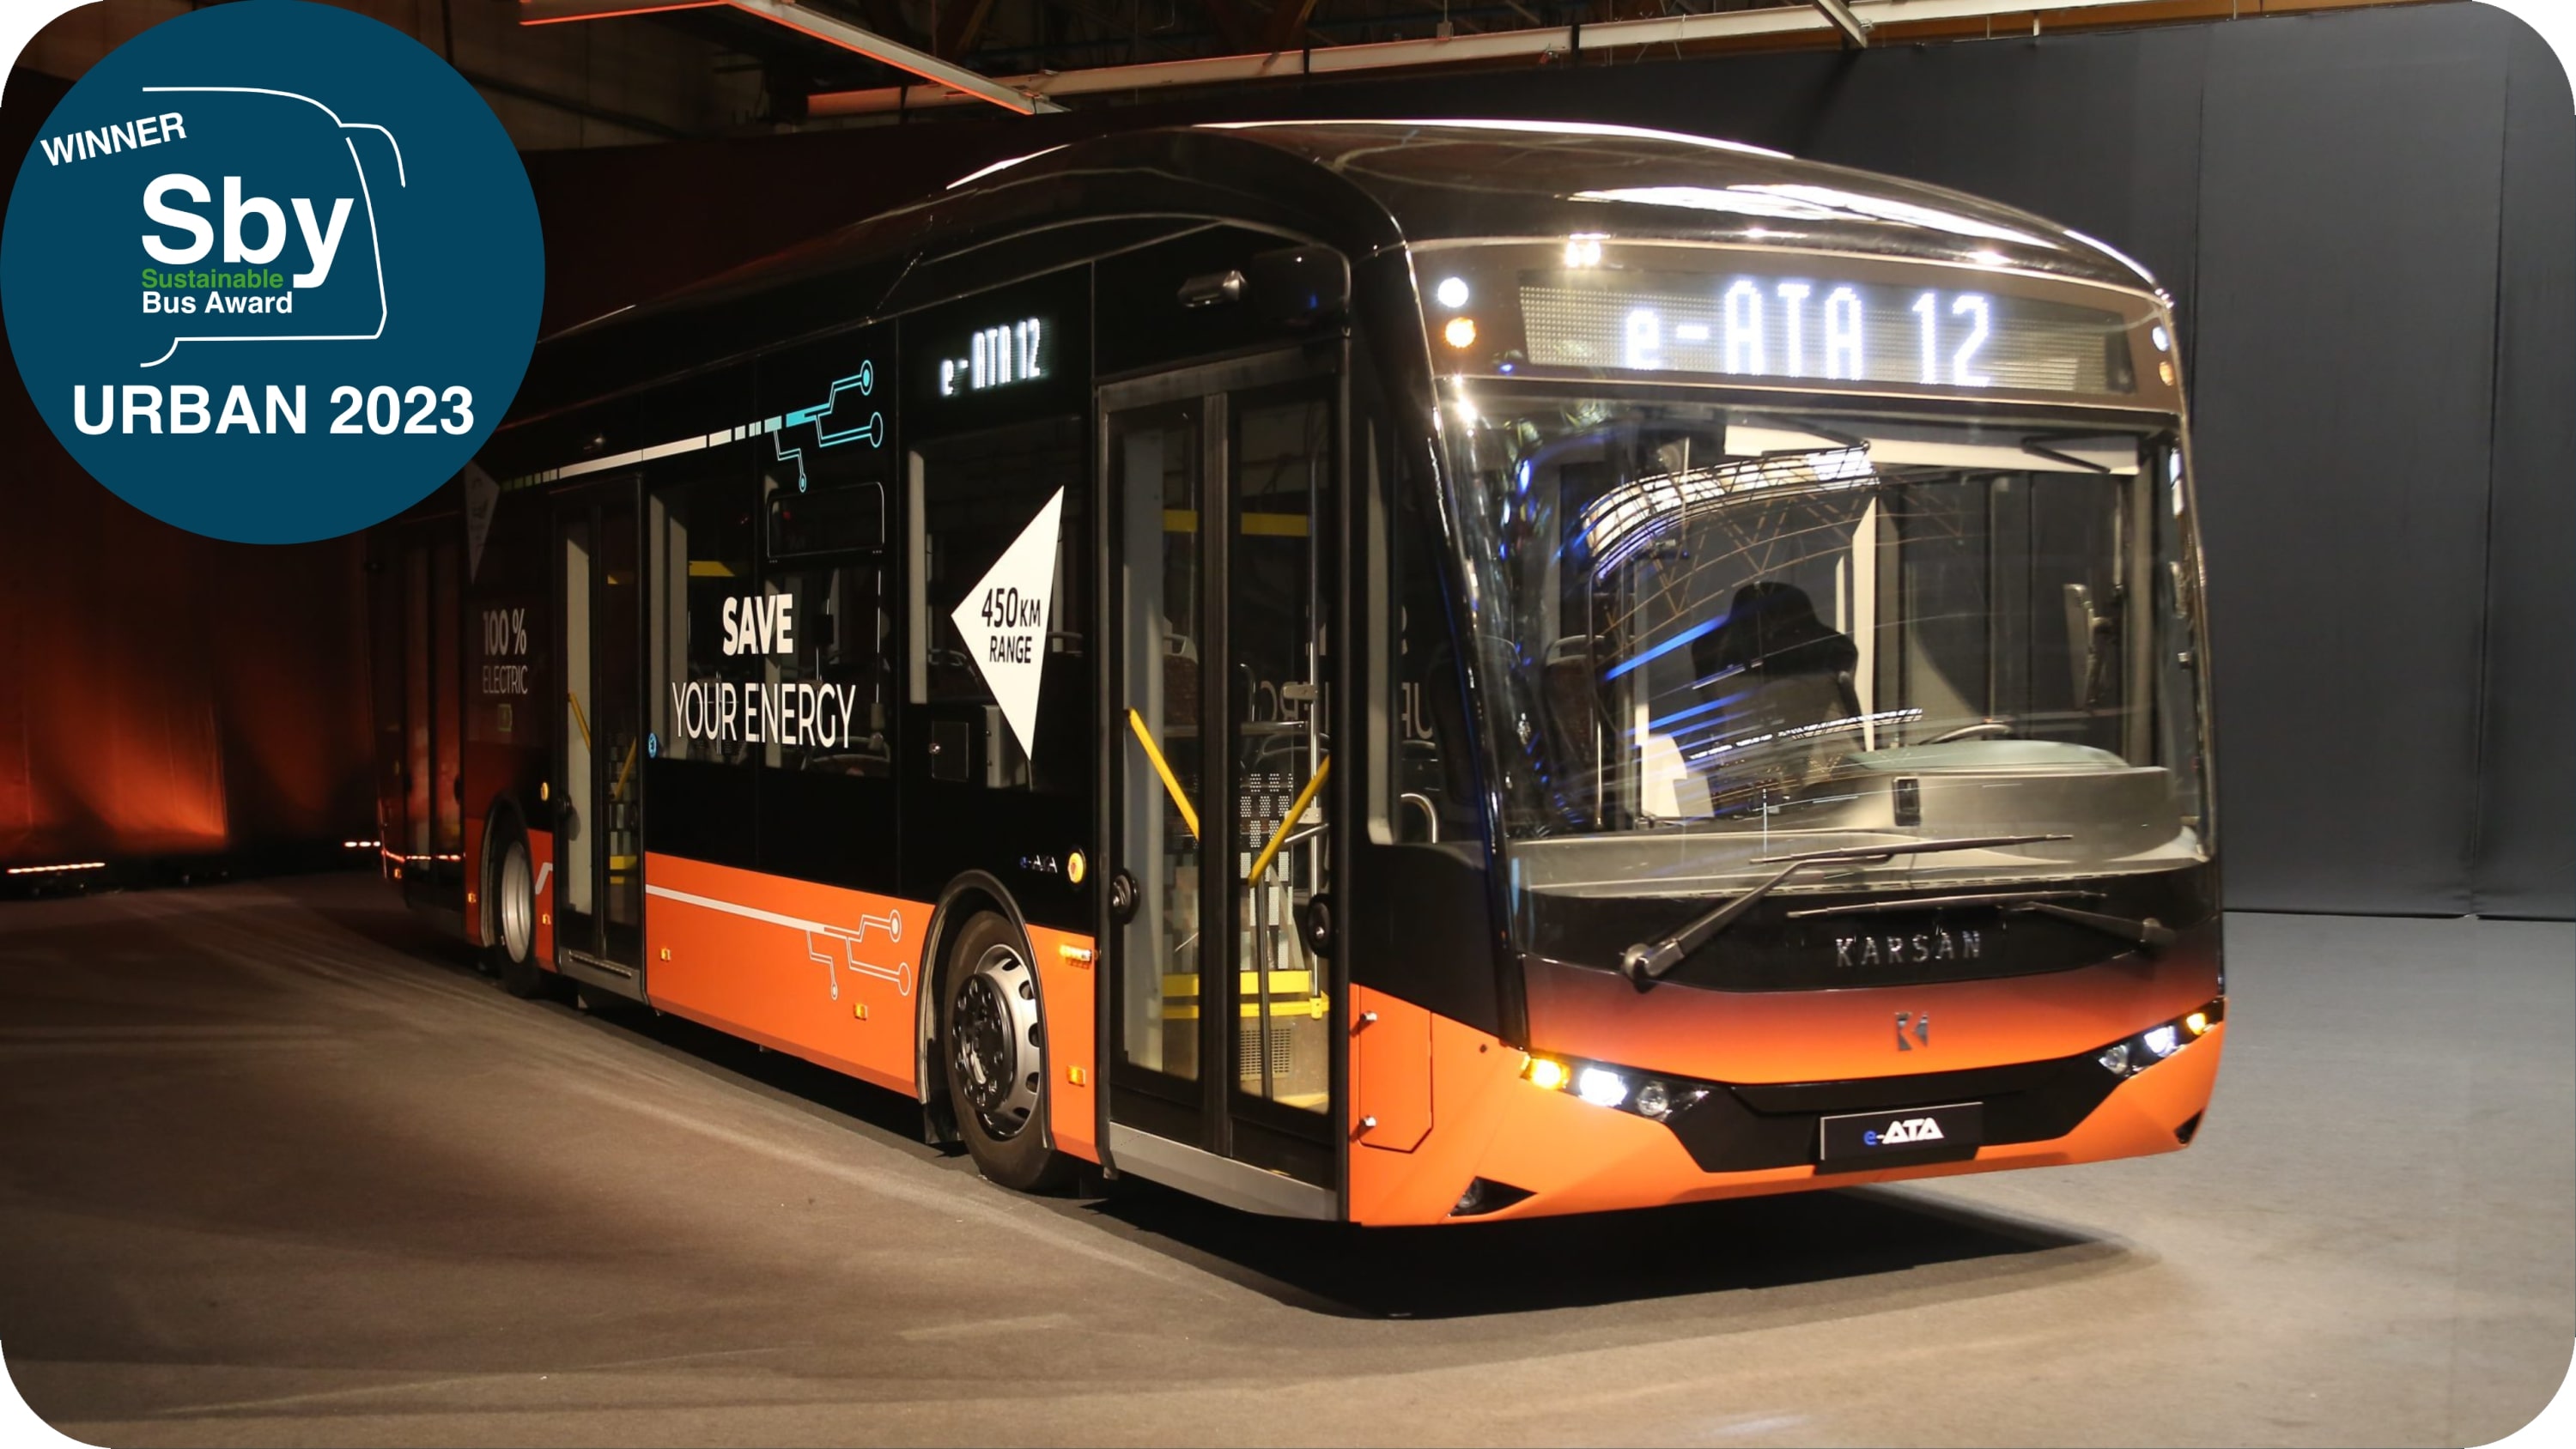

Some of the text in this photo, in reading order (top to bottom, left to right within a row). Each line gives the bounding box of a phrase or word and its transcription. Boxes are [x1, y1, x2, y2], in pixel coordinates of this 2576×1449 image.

[1016, 317, 1041, 379] 12
[1625, 279, 1990, 387] e-ATA 12
[483, 609, 509, 657] 100
[722, 593, 793, 656] SAVE
[989, 635, 1032, 664] RANGE
[483, 664, 529, 695] ELECTRIC
[672, 682, 856, 749] YOUR ENERGY
[1836, 931, 1981, 967] KARSAN
[1863, 1117, 1944, 1145] e-ATA
